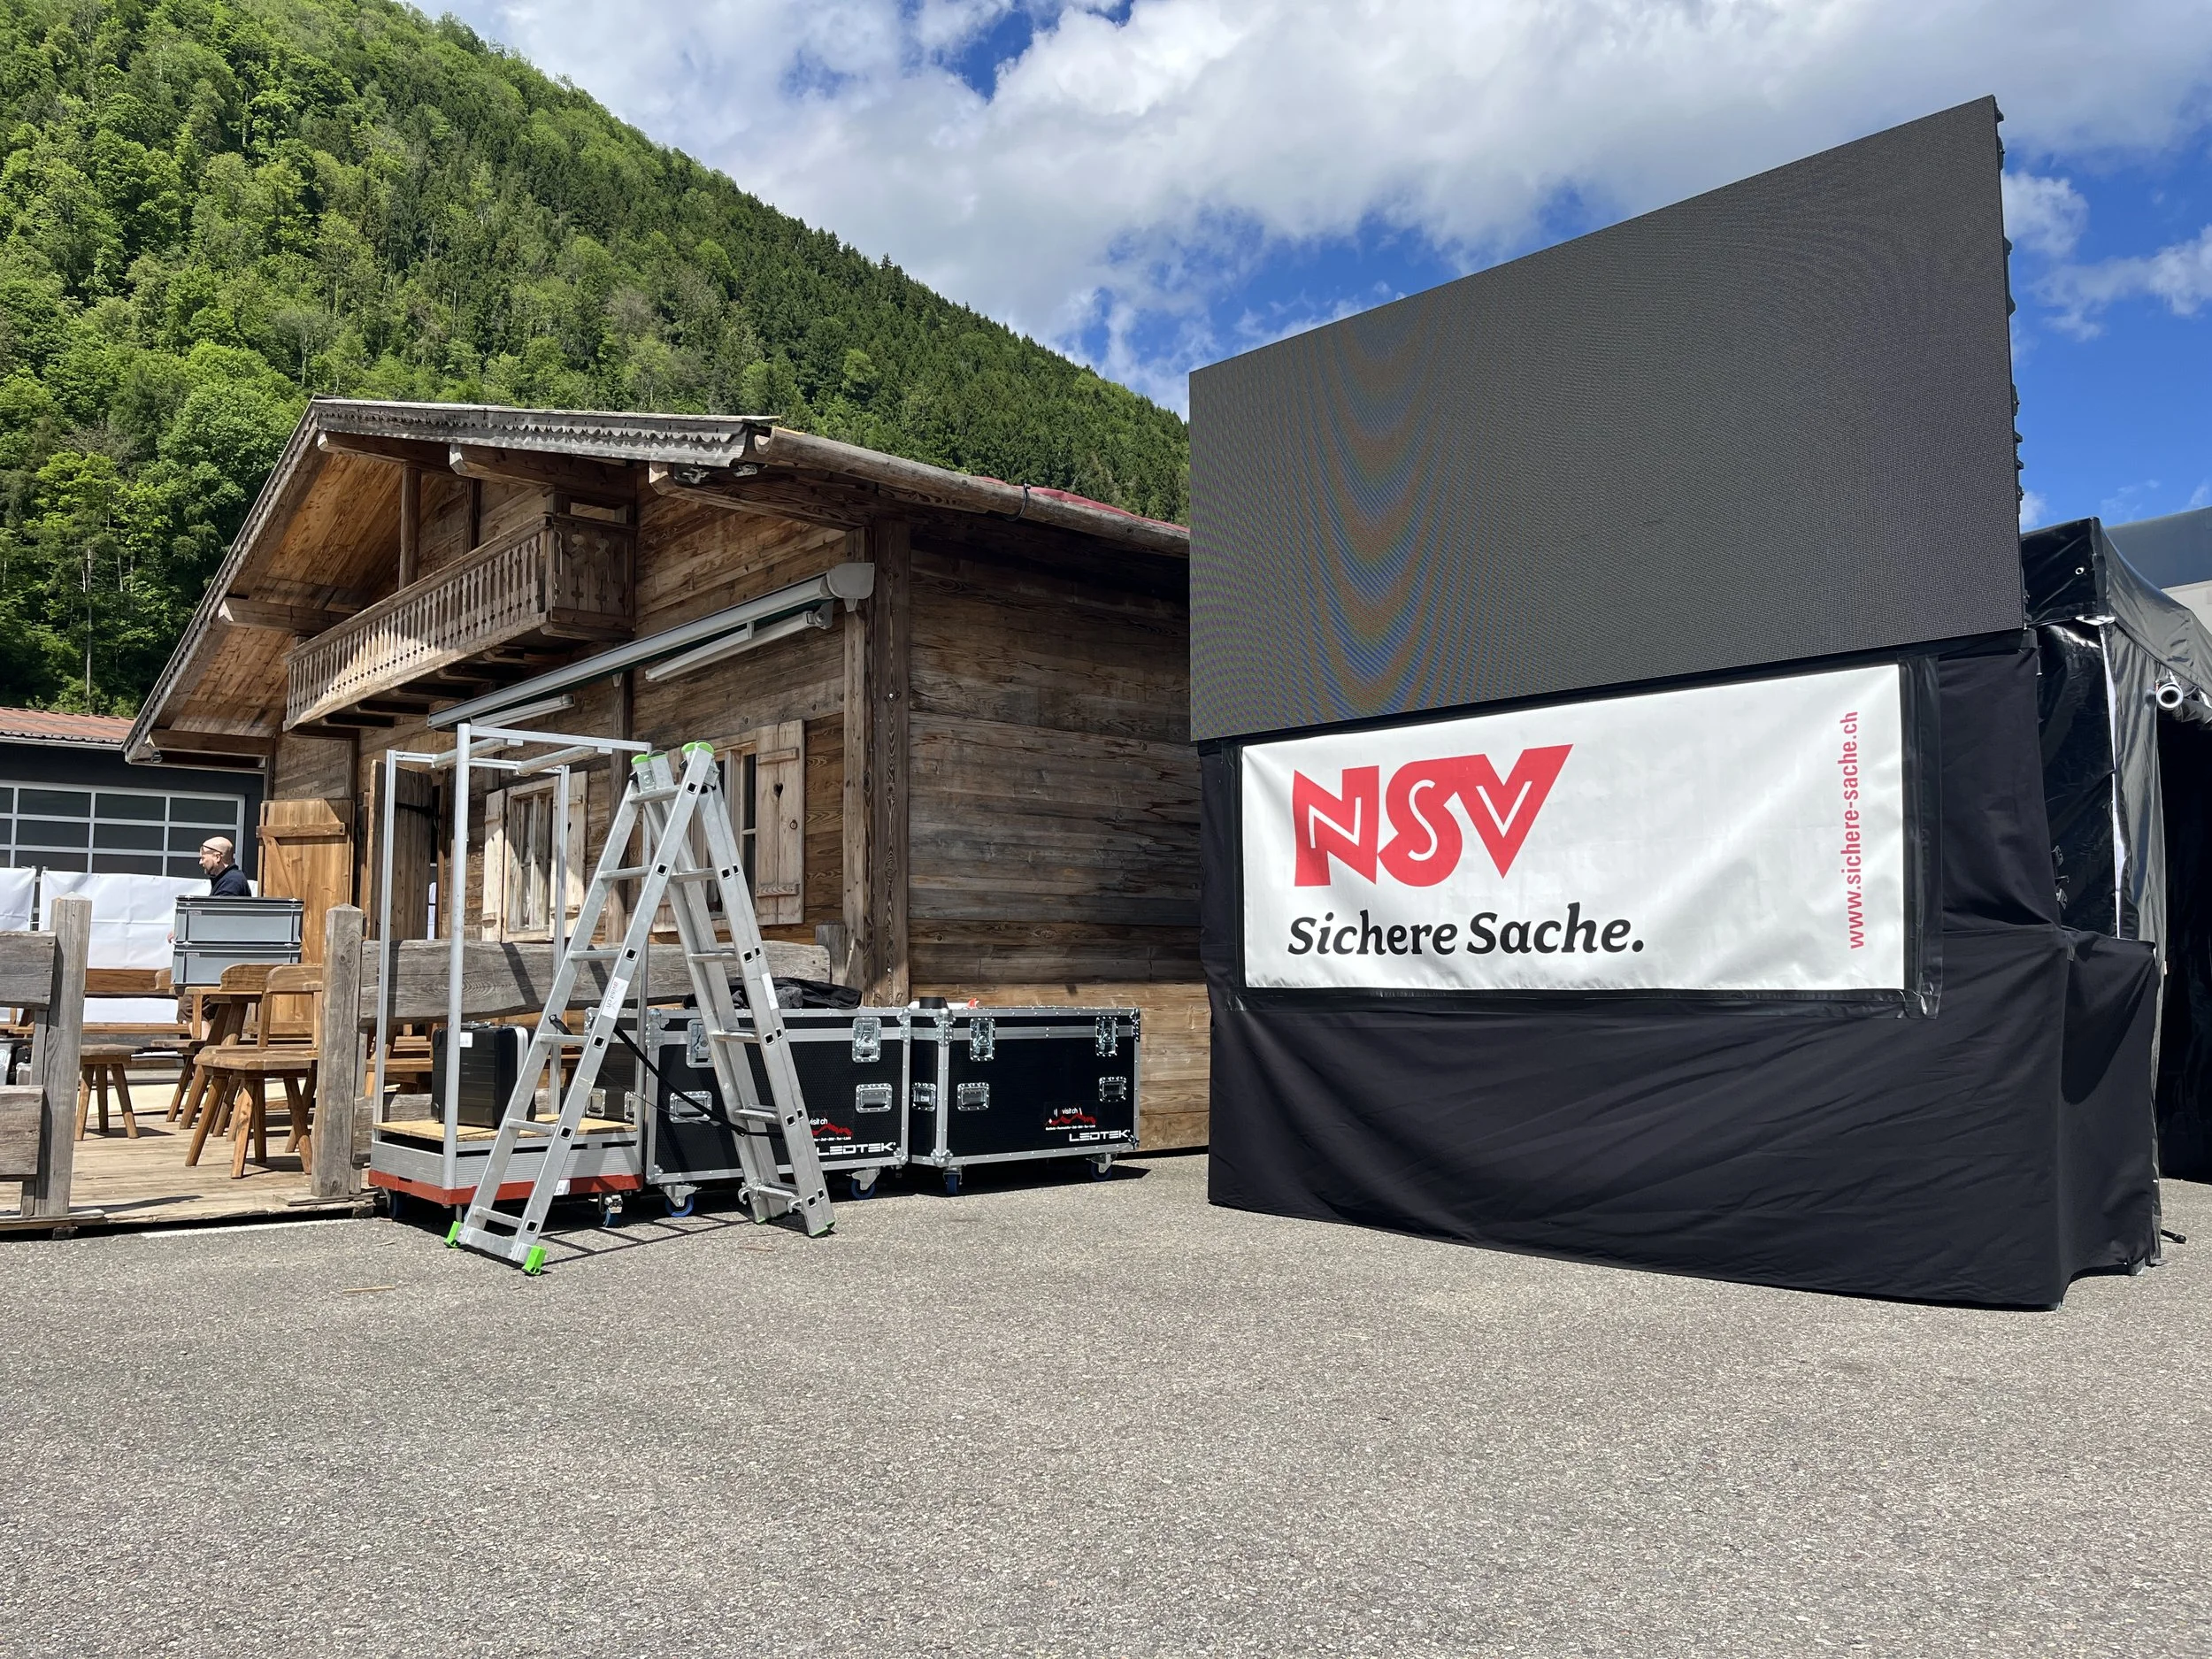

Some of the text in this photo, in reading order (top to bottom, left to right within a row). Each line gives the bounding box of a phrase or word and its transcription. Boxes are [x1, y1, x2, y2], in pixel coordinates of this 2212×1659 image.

[1292, 743, 1574, 887] NSV
[1837, 711, 1864, 949] www.sichere-sache.ch
[1287, 902, 1645, 956] Sichere Sache.
